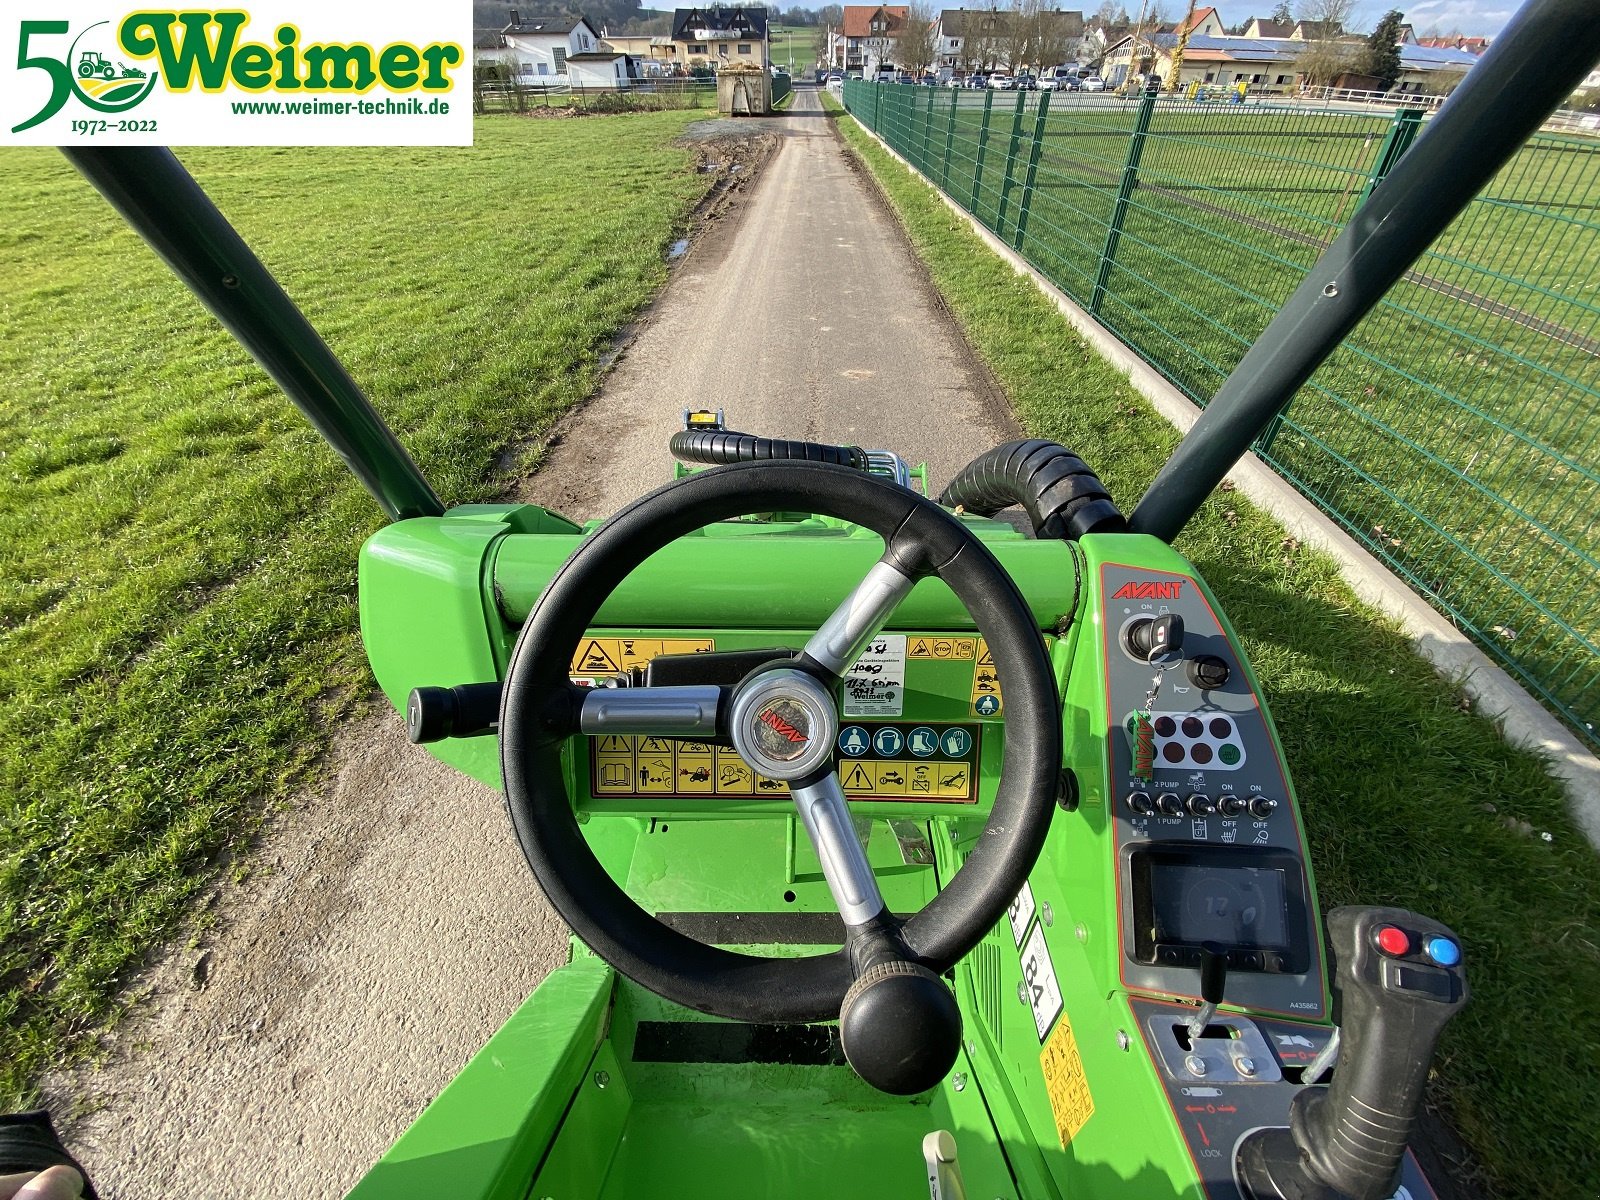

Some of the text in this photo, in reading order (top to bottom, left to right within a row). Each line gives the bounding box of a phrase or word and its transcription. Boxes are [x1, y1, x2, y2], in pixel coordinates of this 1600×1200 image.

[1111, 581, 1183, 600] AVANT
[758, 708, 810, 743] AVANT
[1136, 714, 1155, 781] AVANT
[1154, 780, 1180, 789] 2 PUMP
[1221, 783, 1233, 791] ON
[1249, 784, 1262, 792] ON
[1162, 817, 1182, 825] PUMP
[1221, 820, 1237, 828] OFF
[1252, 821, 1268, 829] OFF
[1025, 953, 1044, 1009] 84
[1200, 1149, 1223, 1158] LOCK
